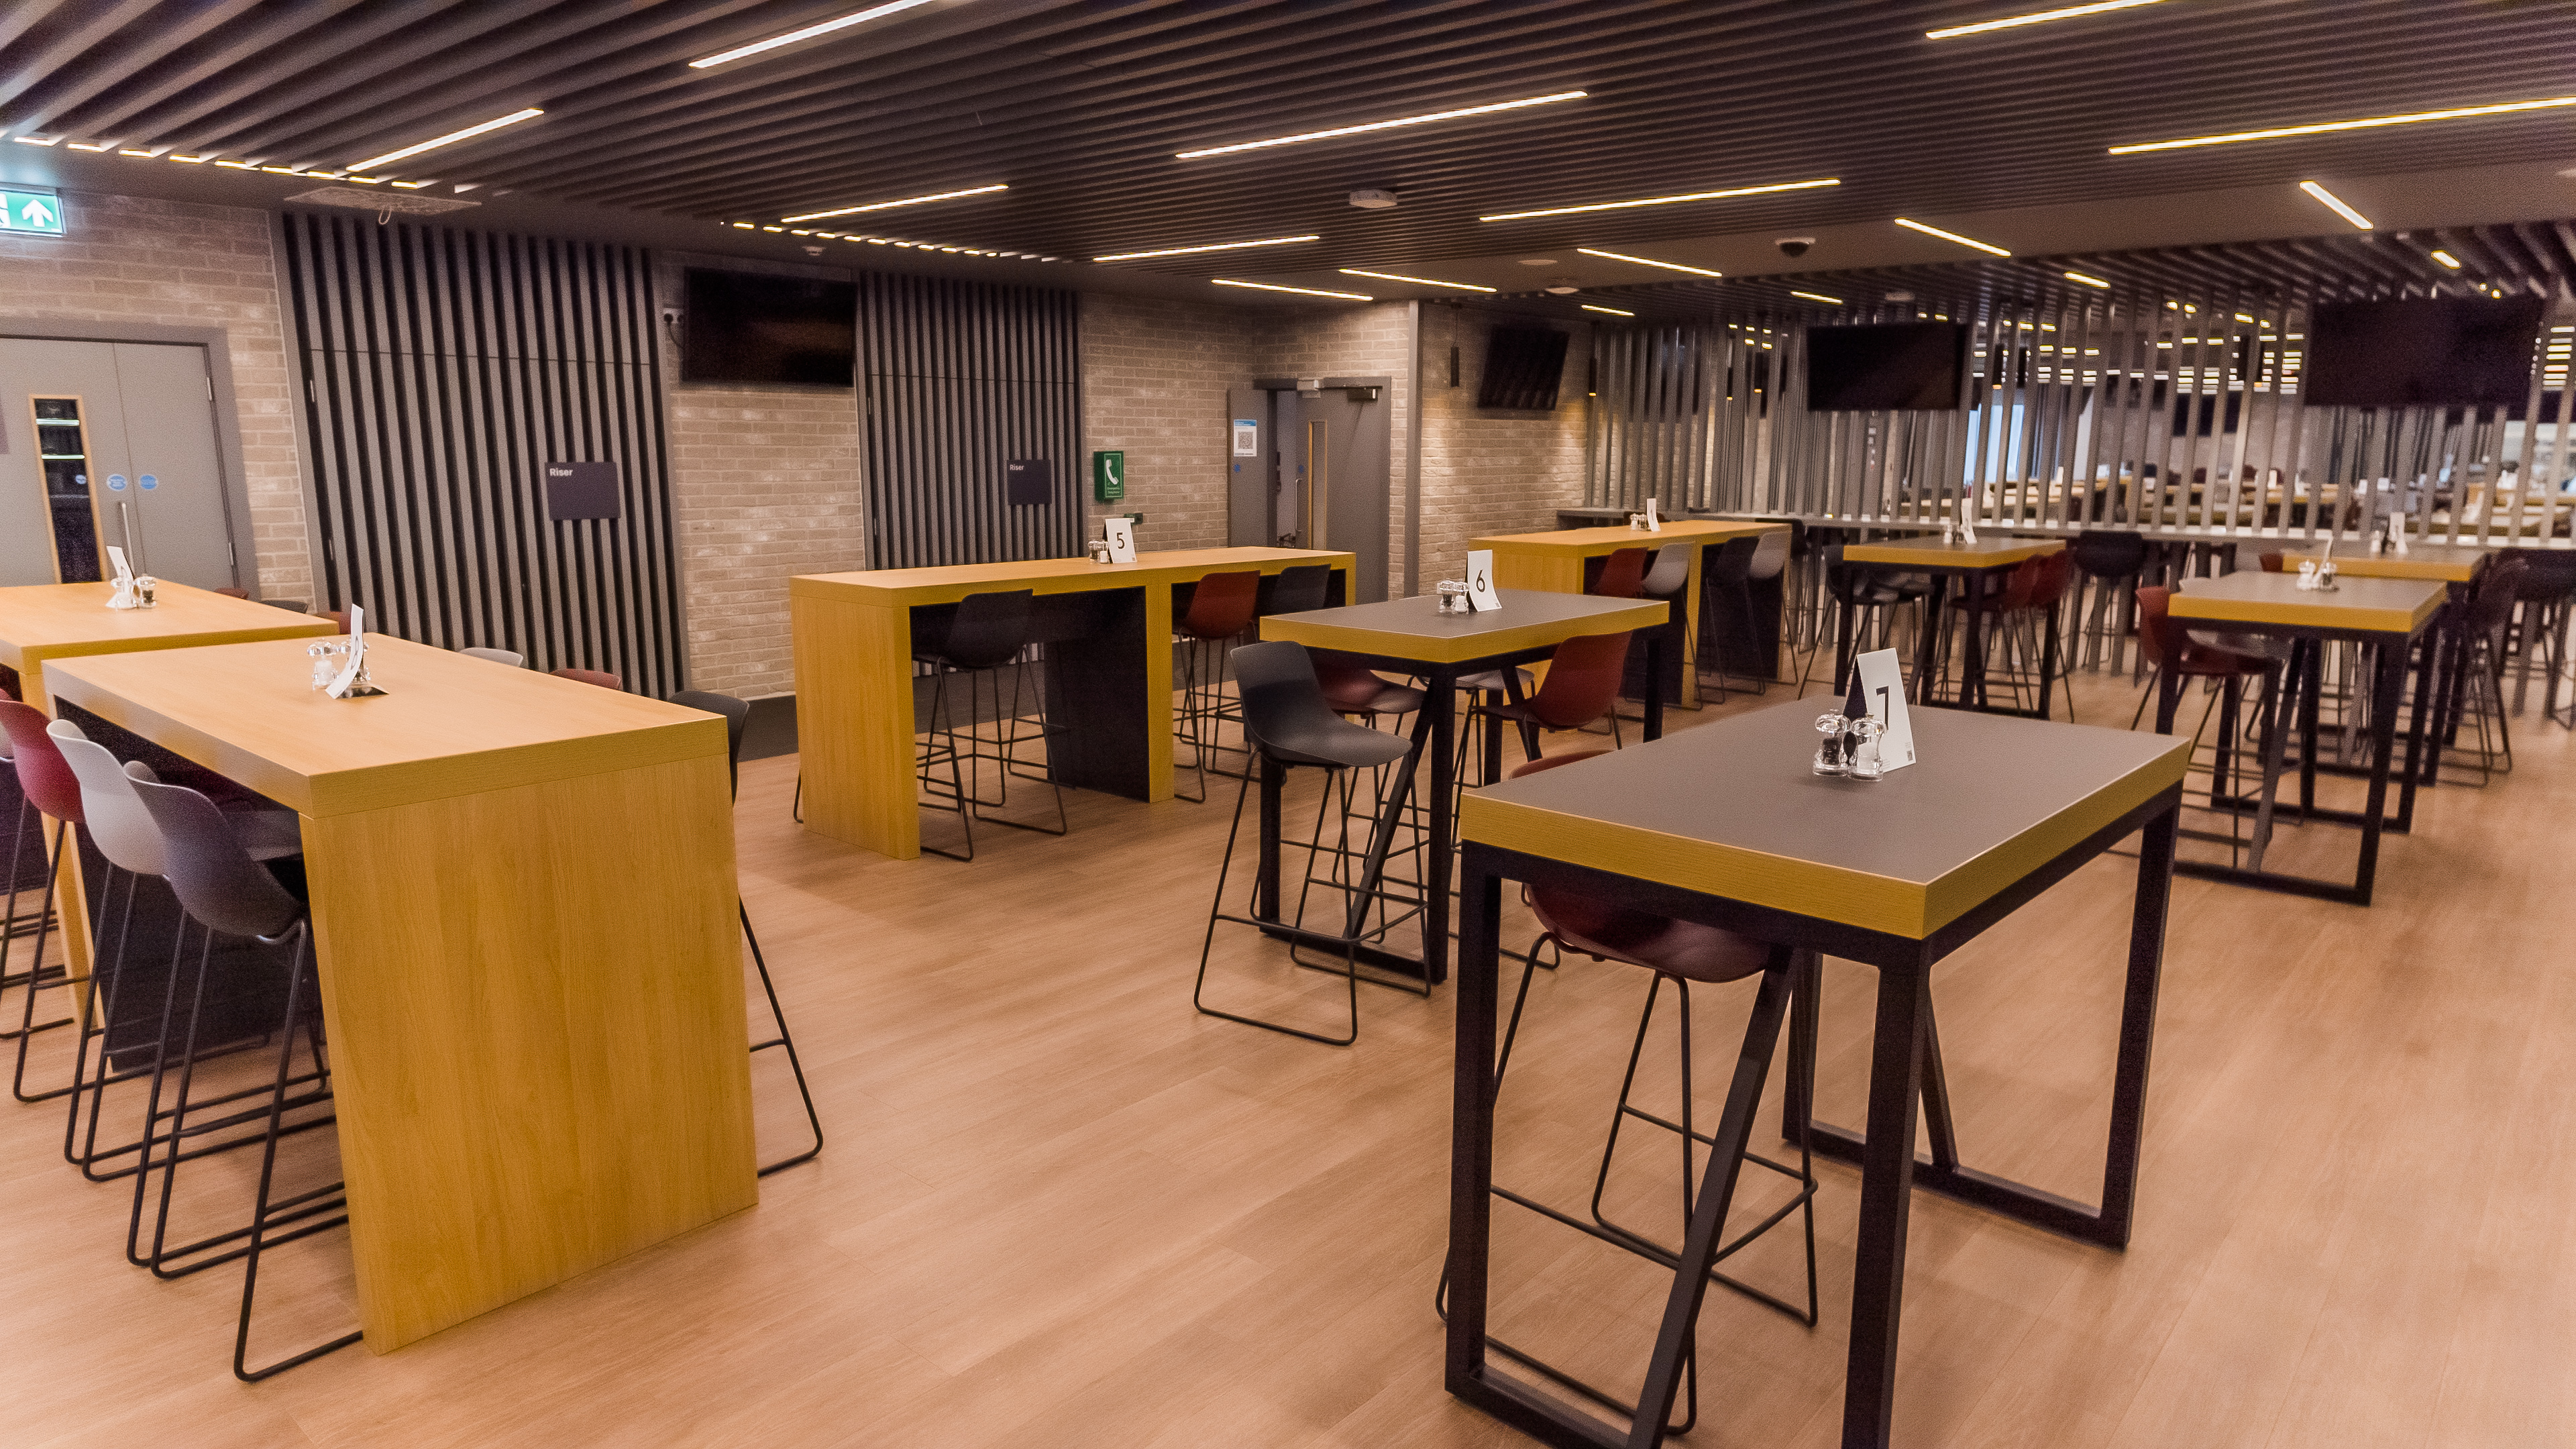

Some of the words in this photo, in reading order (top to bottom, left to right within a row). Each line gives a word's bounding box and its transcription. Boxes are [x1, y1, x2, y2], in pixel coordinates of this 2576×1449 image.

[549, 468, 574, 476] Riser
[1116, 532, 1125, 549] 5
[1476, 569, 1485, 593] 6
[350, 635, 360, 670] 8
[1876, 686, 1889, 731] 7
